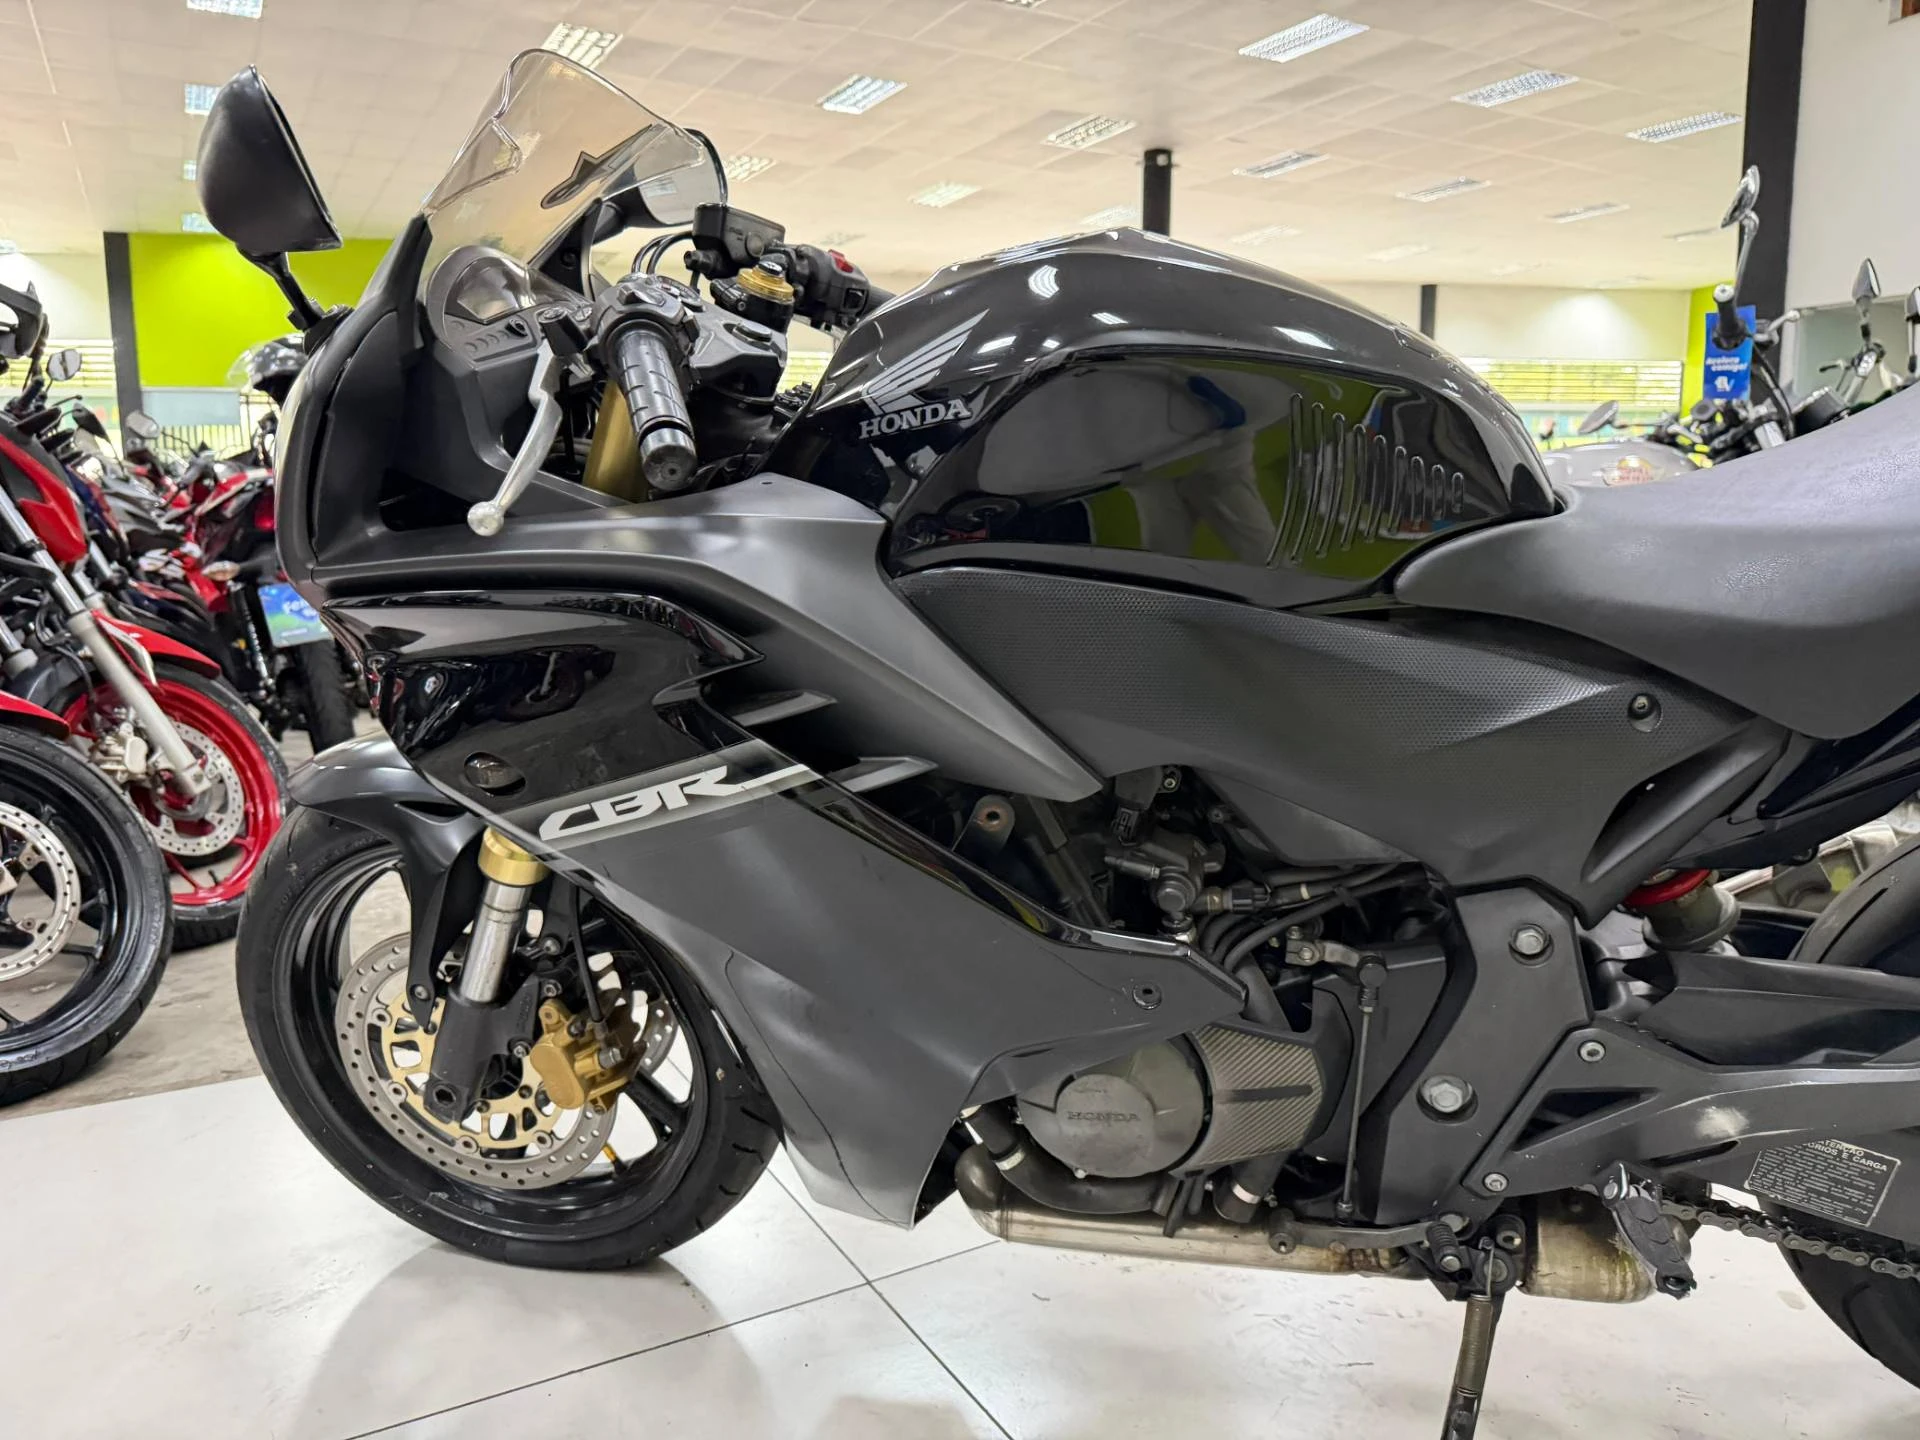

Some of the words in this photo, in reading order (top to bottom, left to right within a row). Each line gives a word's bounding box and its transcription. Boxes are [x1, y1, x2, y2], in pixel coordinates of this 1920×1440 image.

[858, 398, 972, 439] HONDA
[538, 764, 810, 841] CBR
[1066, 1110, 1141, 1123] HONDA
[1841, 1152, 1850, 1160] E
[1852, 1156, 1888, 1172] CARGA
